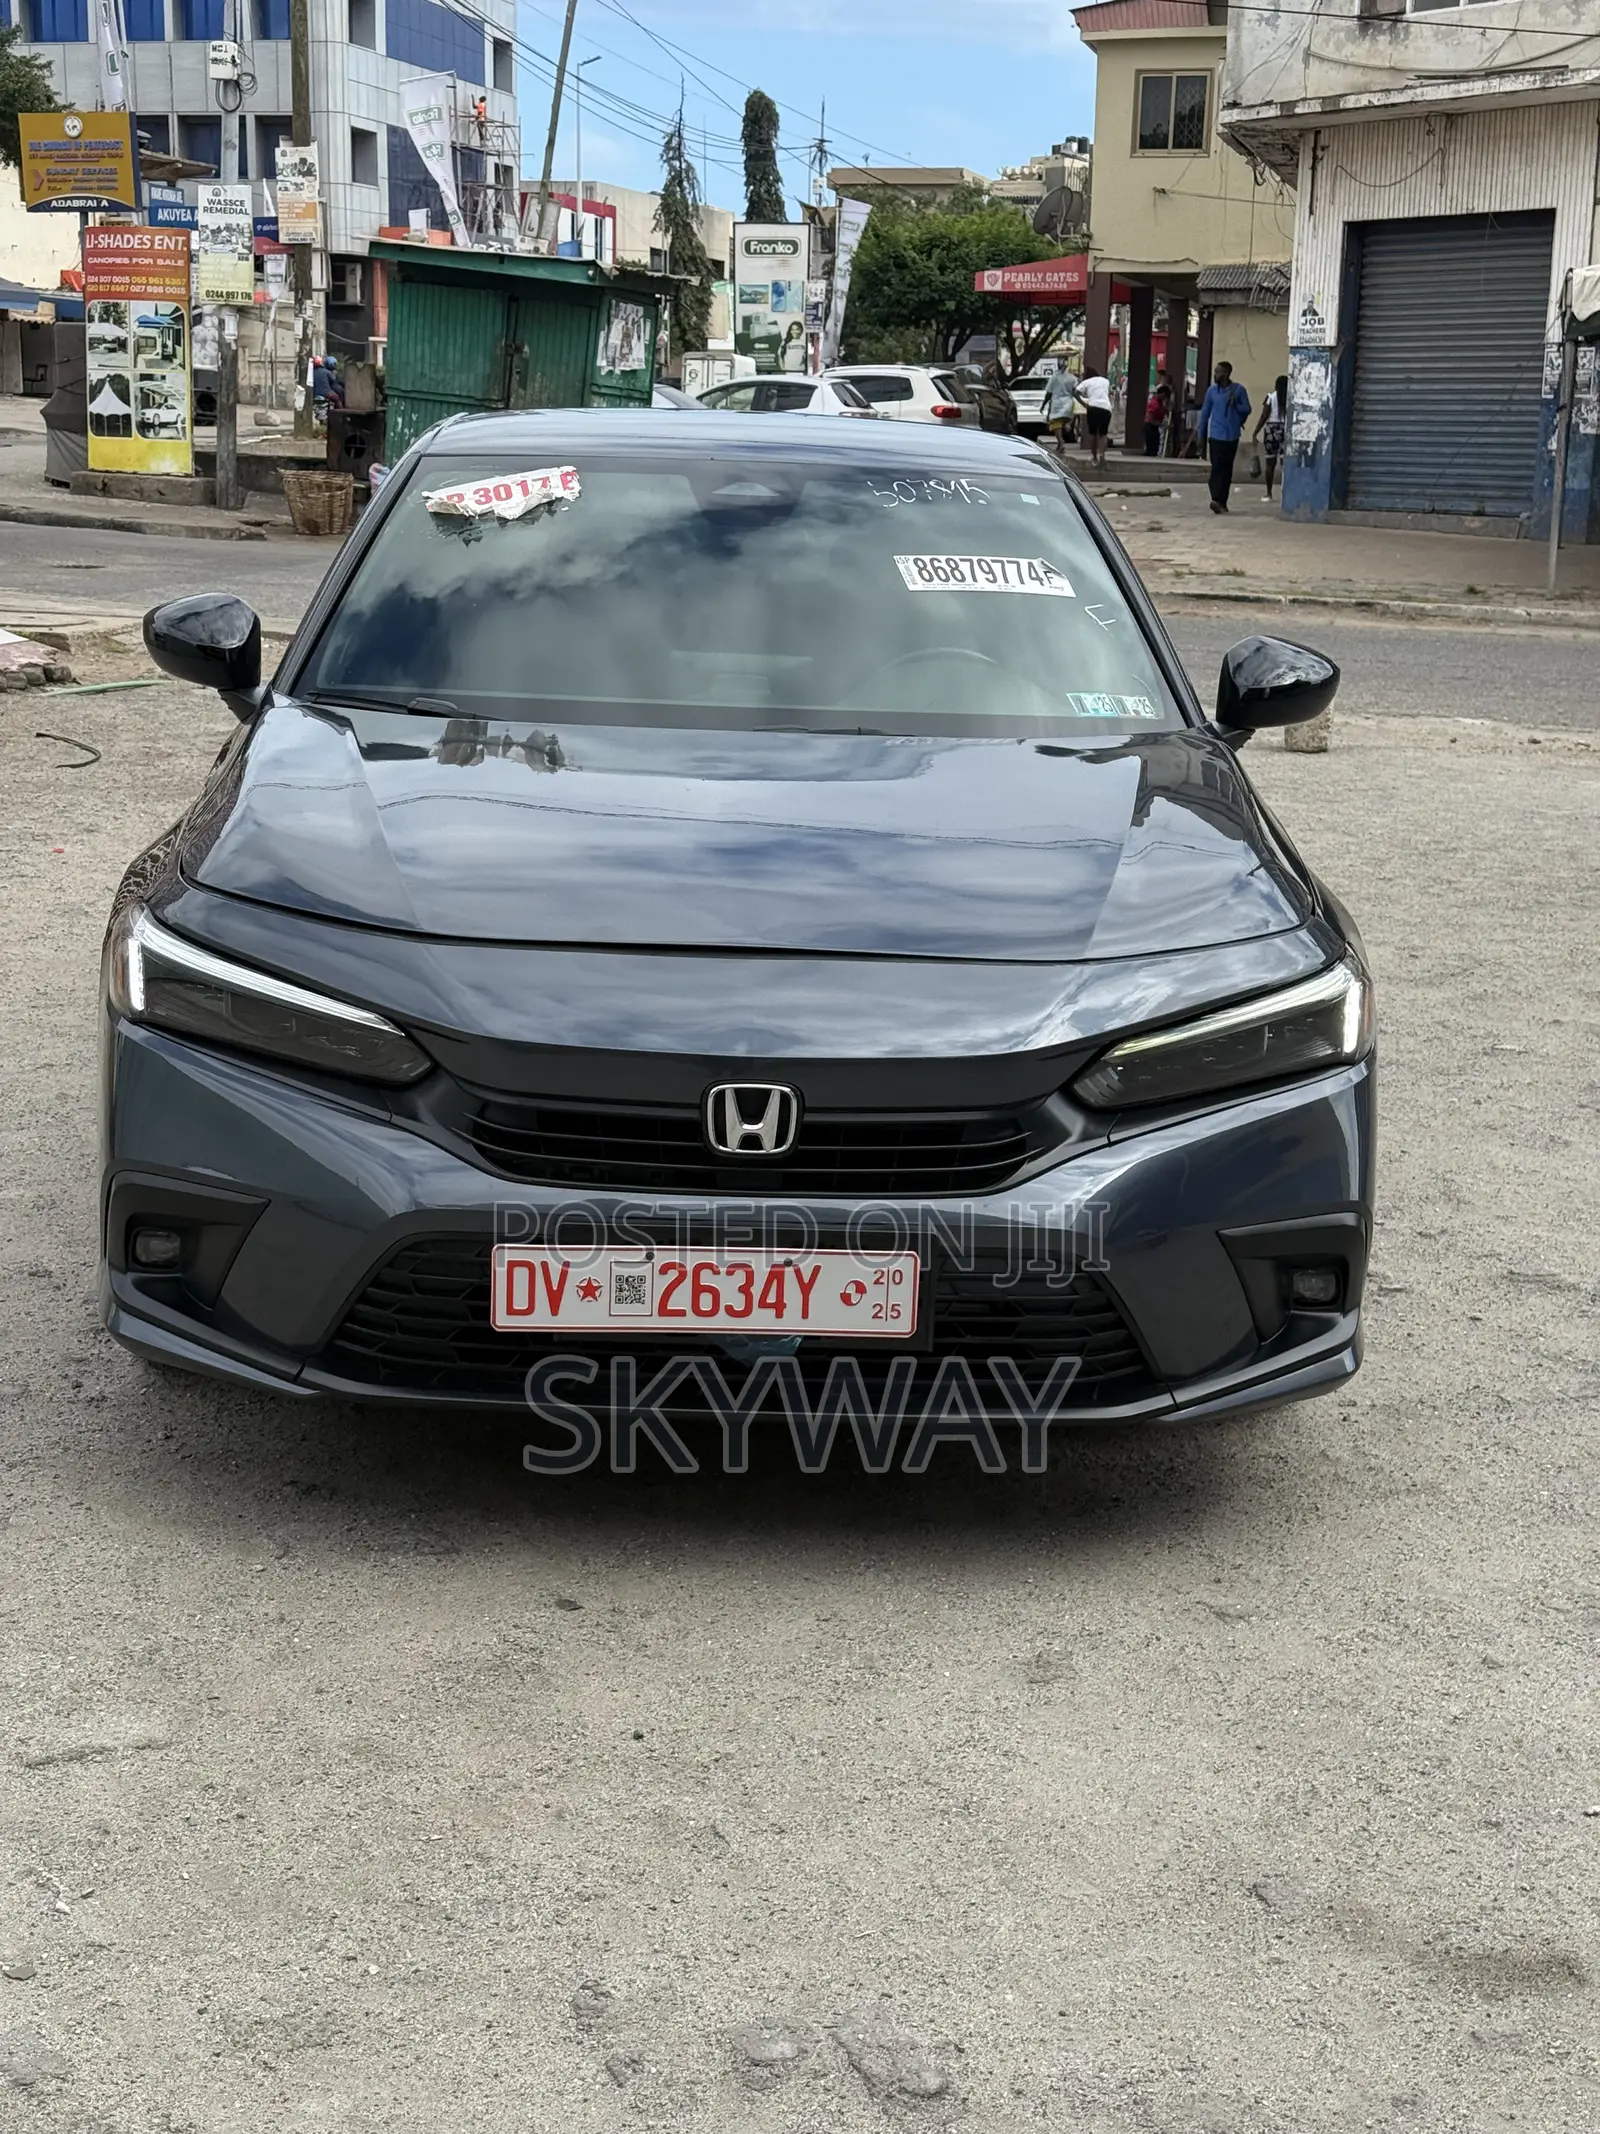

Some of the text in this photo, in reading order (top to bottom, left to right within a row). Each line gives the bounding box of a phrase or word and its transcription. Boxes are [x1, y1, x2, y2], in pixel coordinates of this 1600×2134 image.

[207, 198, 245, 207] WASSCE
[203, 206, 250, 216] REMEDIAL
[154, 236, 187, 251] ENT.
[750, 241, 793, 254] Franko
[133, 257, 153, 265] FOR
[157, 258, 185, 266] SALE
[1004, 272, 1079, 282] PEARLY GATES
[205, 289, 223, 298] 0244
[1301, 317, 1325, 326] JOB
[913, 557, 1045, 586] 86879774
[506, 1260, 822, 1320] DV 2634Y
